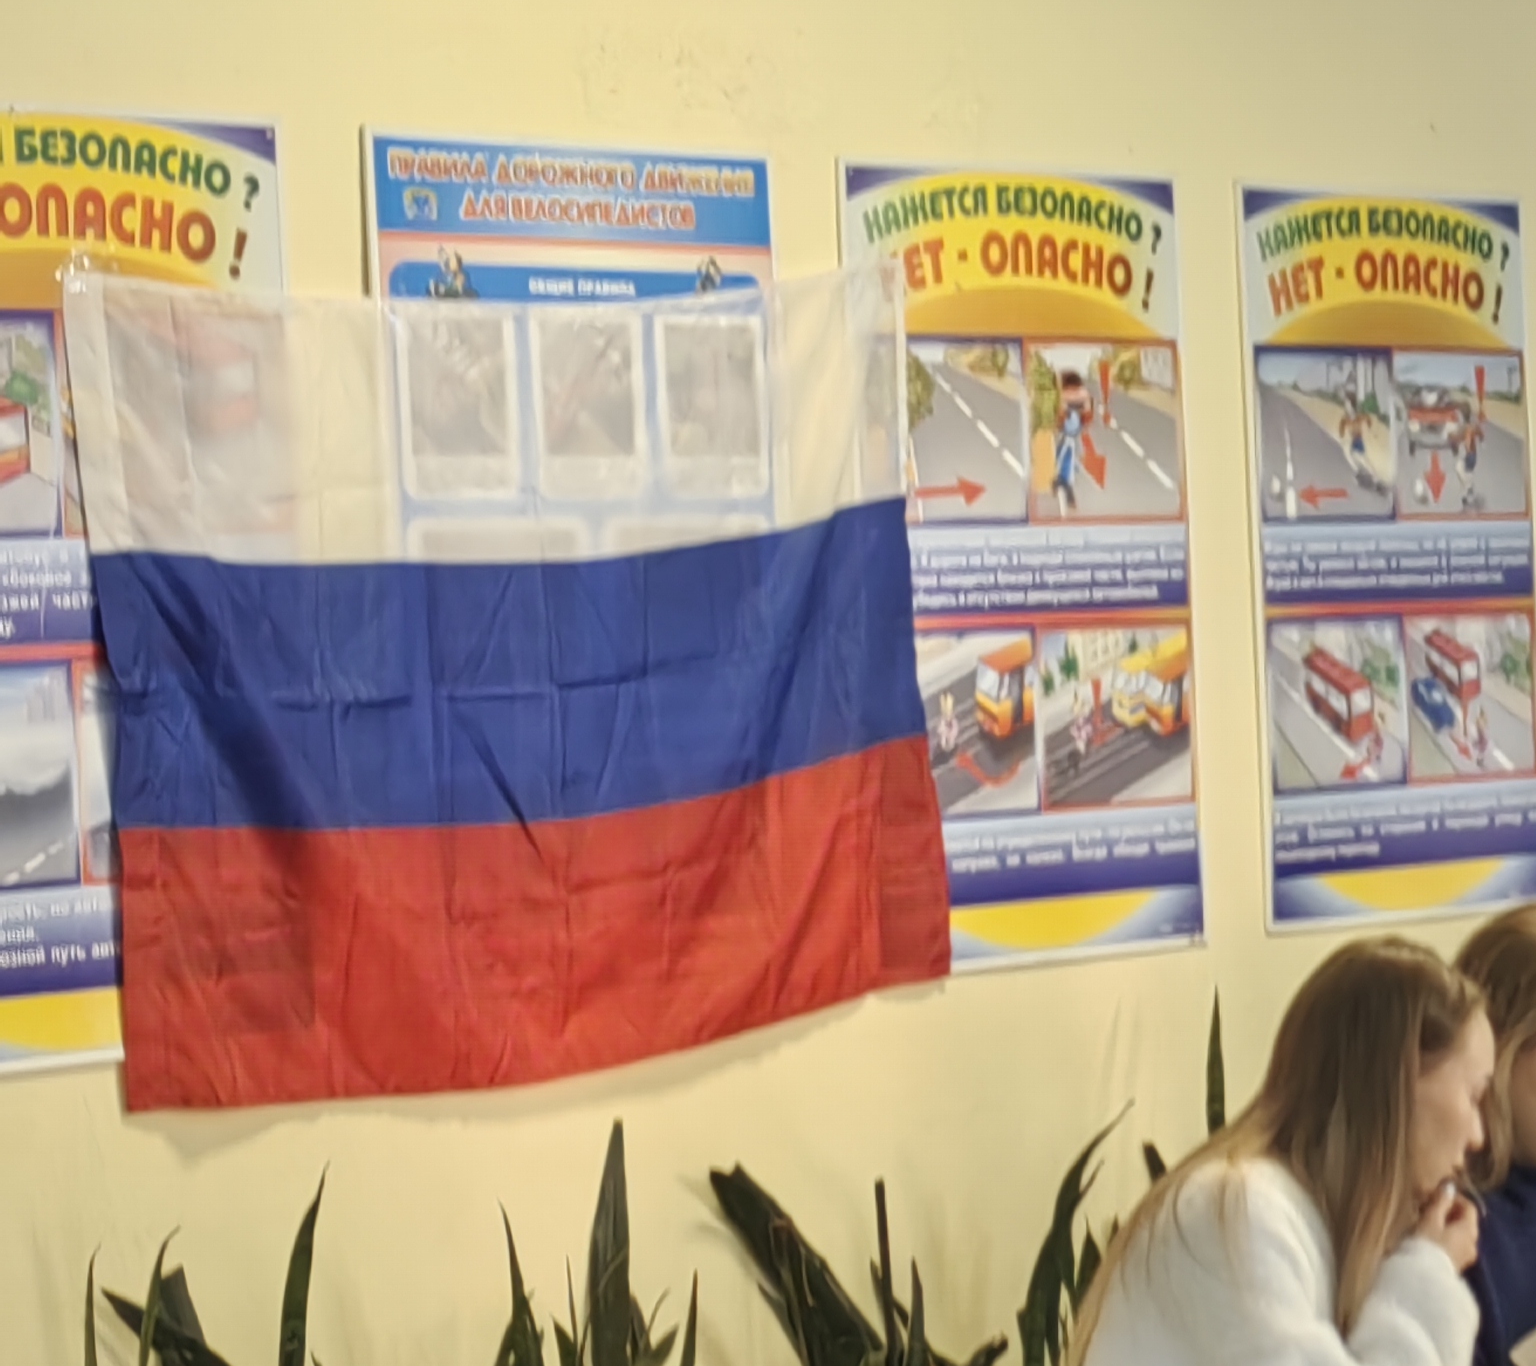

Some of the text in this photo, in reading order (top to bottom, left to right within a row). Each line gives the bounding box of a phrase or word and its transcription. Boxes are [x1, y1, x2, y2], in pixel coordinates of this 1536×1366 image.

[14, 126, 231, 198] БЕЗОПАСНО
[387, 146, 487, 182] ПРАВИЛА
[493, 151, 635, 191] ДОРОЖНОГО
[0, 182, 216, 265] ОПАСНО
[460, 188, 696, 230] ДЛЯ ВЕЛОСИПЕДИСТОВ
[863, 183, 988, 243] КАЖЕТСЯ
[996, 183, 1143, 241] БЕЗОПАСНО
[1257, 206, 1361, 262] КАЖЕТСЯ
[1367, 206, 1493, 261] БЕЗОПАСНО
[980, 229, 1132, 298] ОПАСНО
[1268, 255, 1324, 317] НЕТ
[1355, 249, 1484, 311] ОПАСНО
